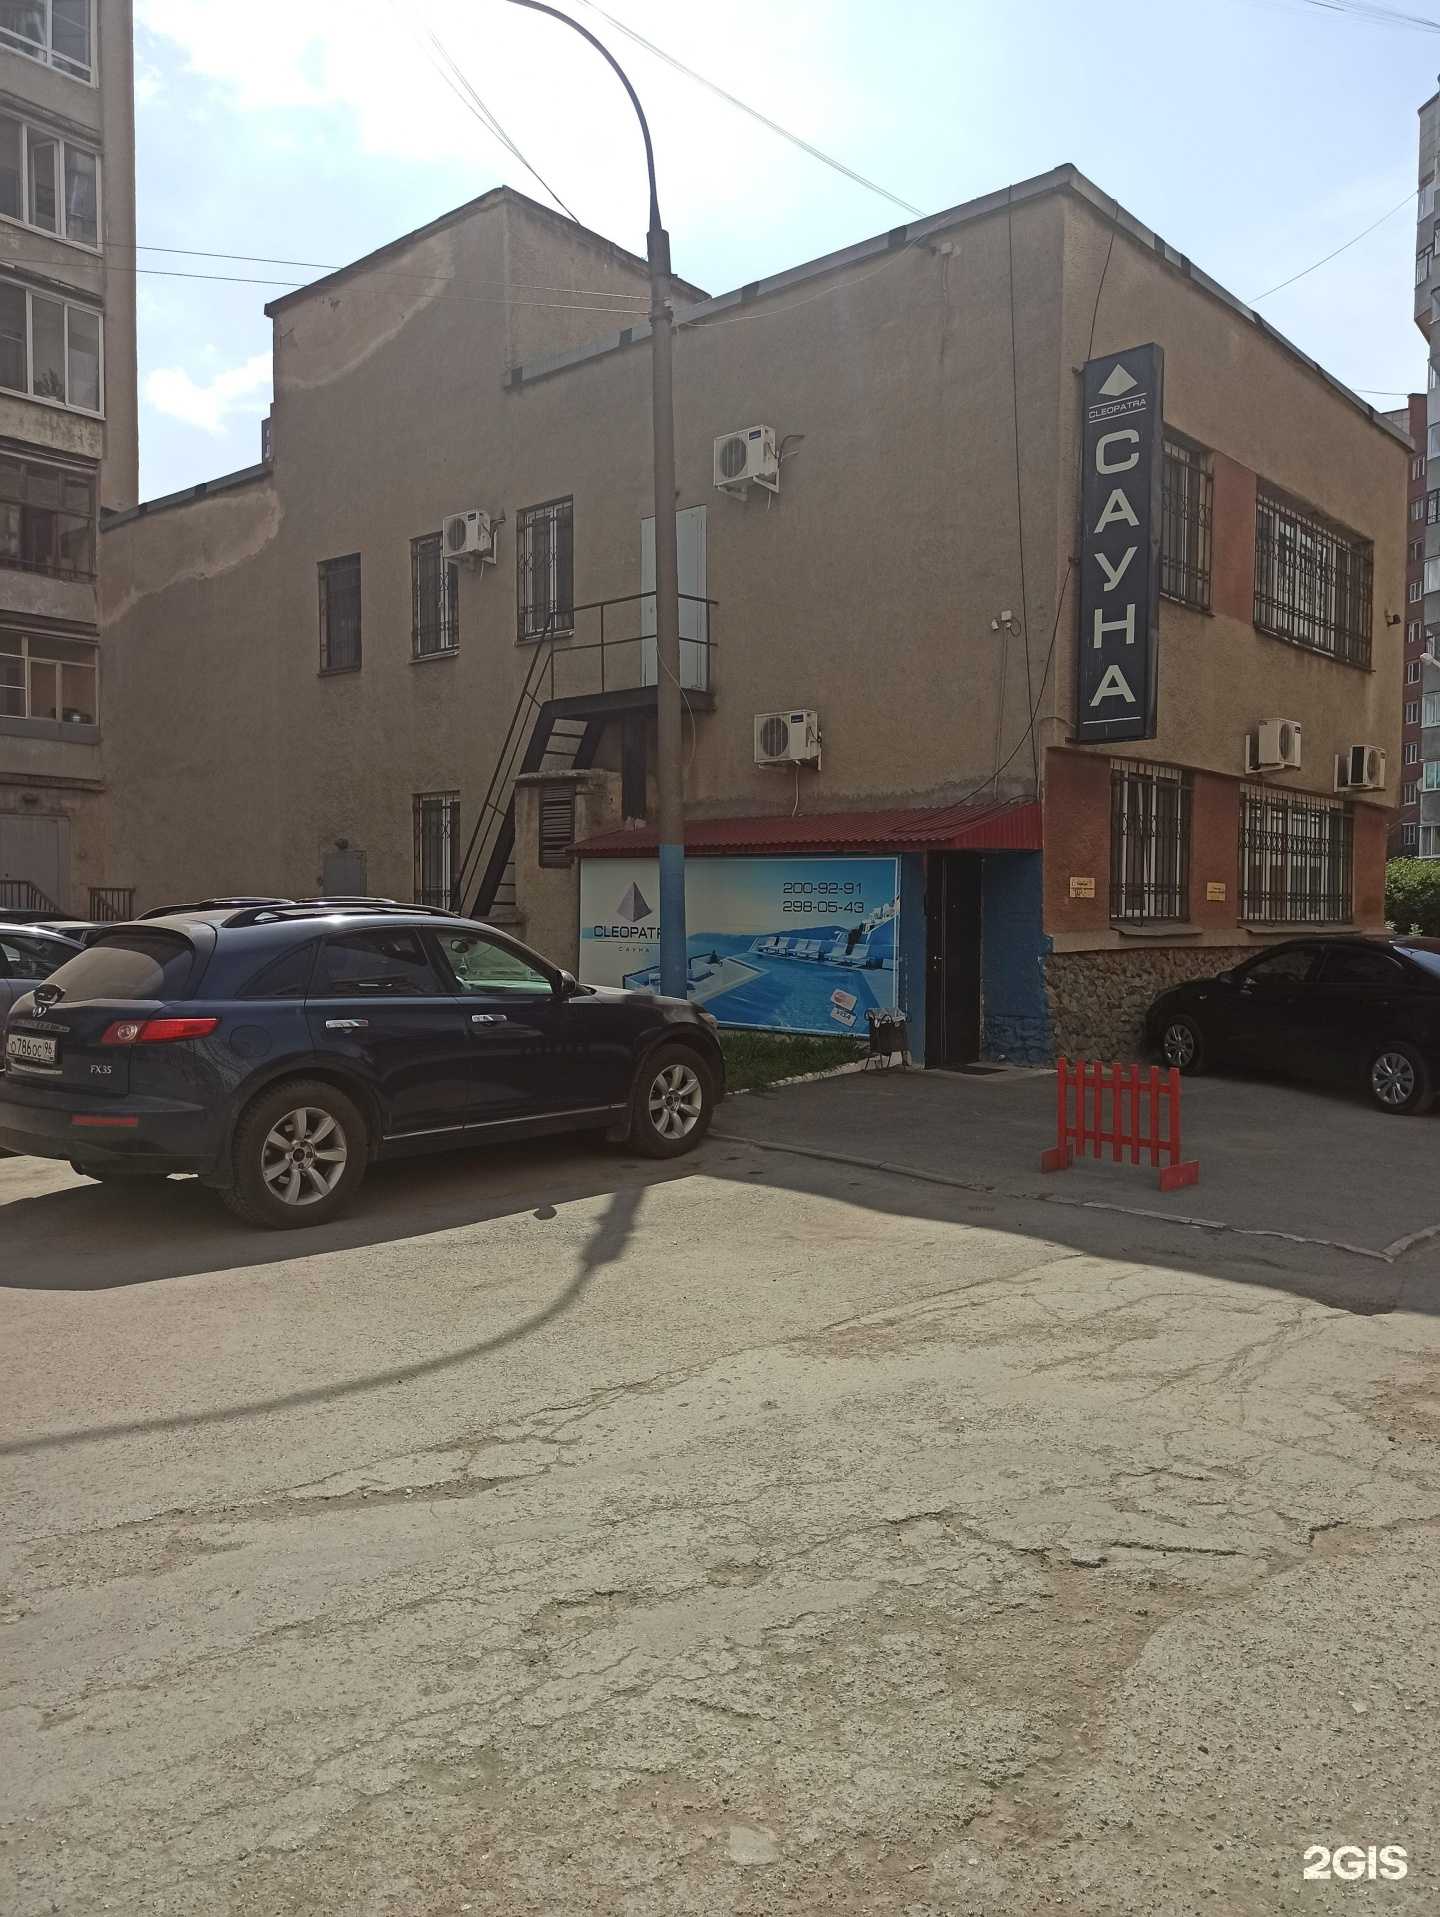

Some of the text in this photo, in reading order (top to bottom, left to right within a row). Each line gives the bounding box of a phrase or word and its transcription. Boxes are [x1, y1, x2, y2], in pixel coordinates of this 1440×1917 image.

[1088, 398, 1147, 419] CLEOPATRA
[1088, 429, 1140, 707] САУНА
[783, 882, 862, 895] 200-92-91
[782, 900, 865, 914] 298-05-43
